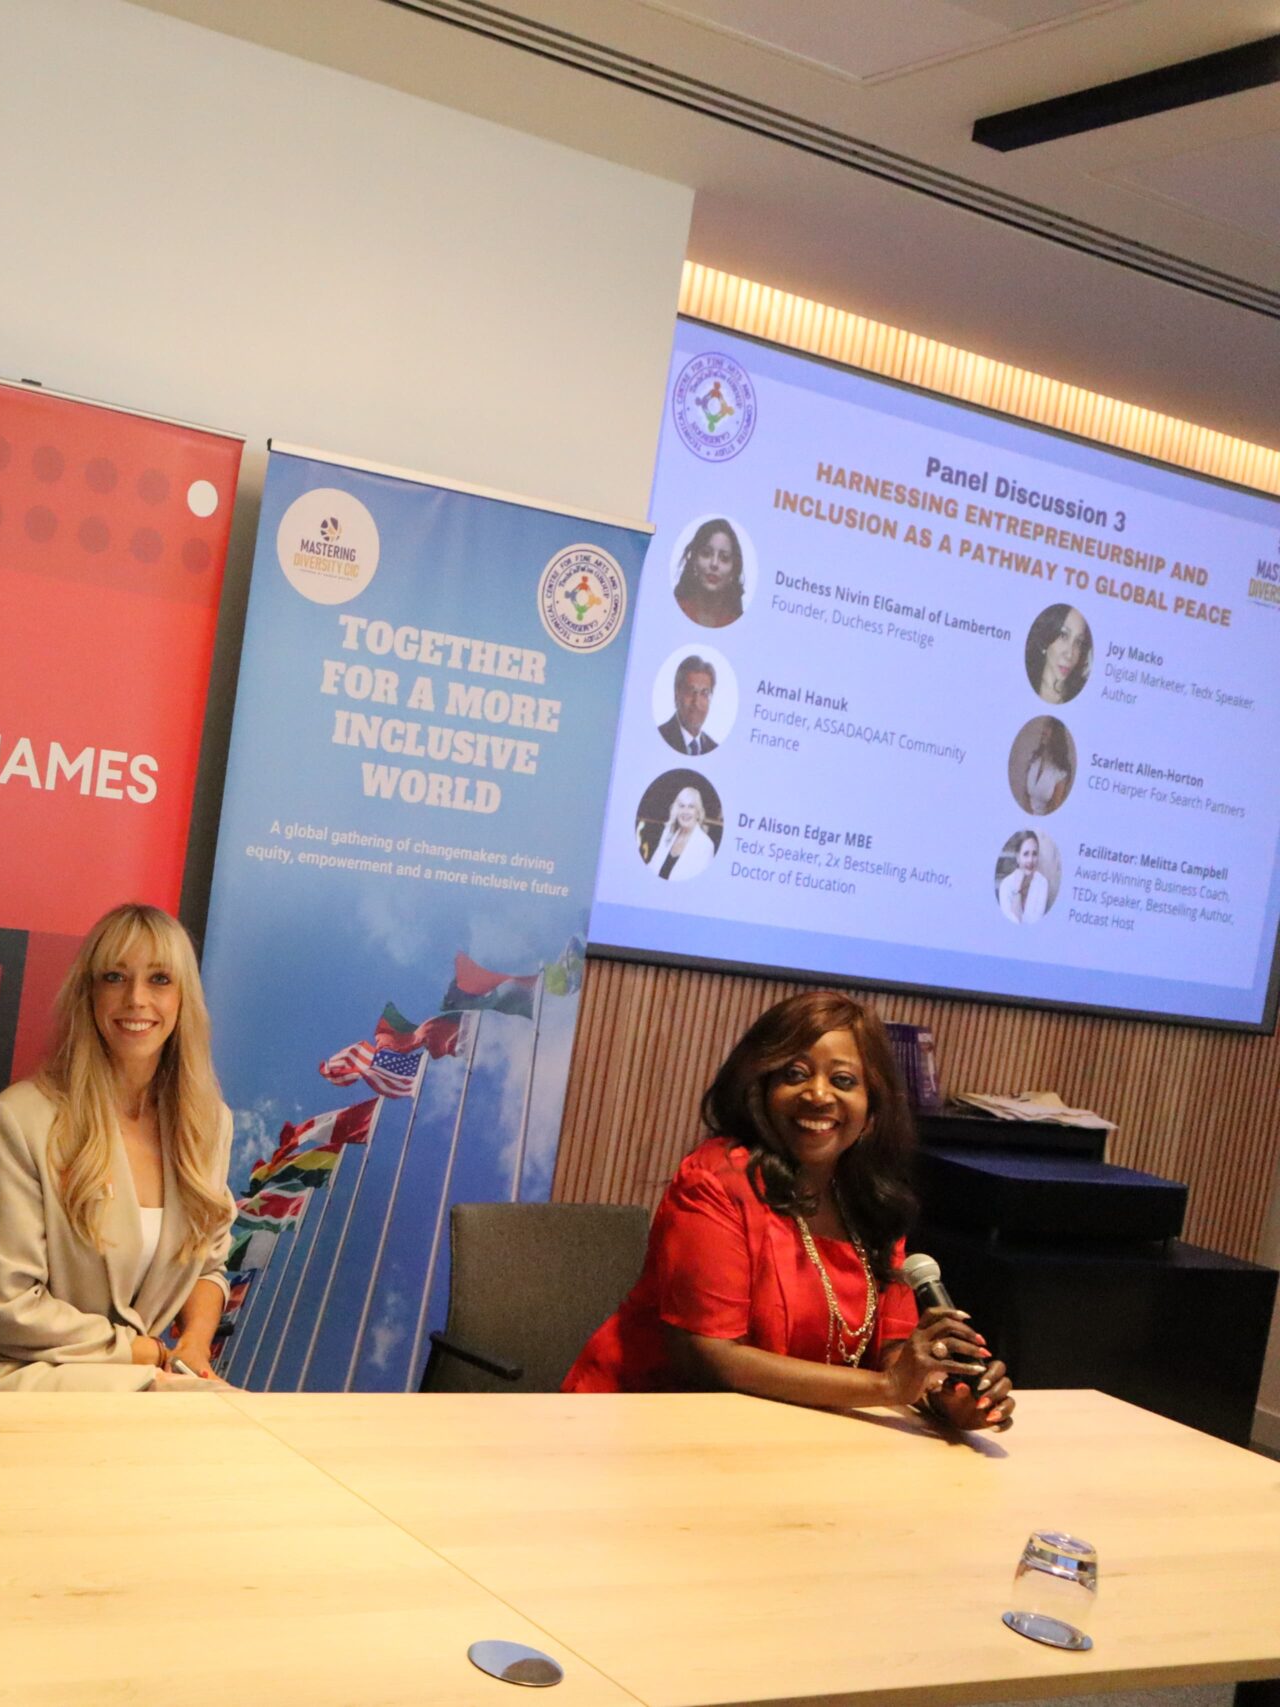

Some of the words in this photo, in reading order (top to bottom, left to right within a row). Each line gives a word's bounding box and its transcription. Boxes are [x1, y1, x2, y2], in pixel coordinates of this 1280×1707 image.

[925, 456, 989, 493] Panel
[994, 476, 1108, 527] Discussion
[1113, 511, 1127, 533] 3
[816, 461, 959, 519] HARNESSING
[965, 503, 1166, 575] ENTREPRENEURSHIP
[1170, 562, 1209, 587] AND
[293, 553, 344, 574] DIVERSITY
[344, 562, 360, 578] CIC
[300, 538, 356, 562] MASTERING
[773, 488, 899, 540] INCLUSION
[903, 524, 933, 549] AS
[938, 534, 952, 554] A
[959, 539, 1059, 581] PATHWAY
[1064, 566, 1090, 590] TO
[1095, 575, 1169, 611] GLOBAL
[1173, 596, 1232, 627] PEACE
[775, 570, 831, 598] Duchess
[835, 585, 870, 607] Nivin
[873, 595, 925, 621] ElGamal
[928, 610, 942, 625] of
[944, 612, 1012, 641] Lamberton
[1248, 576, 1280, 604] DIVER
[771, 594, 828, 625] Founder,
[831, 609, 884, 636] Duchess
[886, 622, 935, 649] Prestige
[338, 613, 547, 685] TOGETHER
[1106, 641, 1126, 661] Joy
[1127, 645, 1164, 667] Macko
[320, 659, 399, 705] FOR
[407, 676, 436, 713] A
[444, 682, 562, 734] MORE
[756, 679, 802, 703] Akmal
[805, 690, 849, 713] Hanuk
[1100, 685, 1138, 704] Author
[1104, 662, 1138, 683] Digital
[1139, 671, 1188, 696] Marketer,
[1190, 683, 1213, 700] Tedx
[1215, 689, 1256, 712] Speaker,
[331, 709, 540, 775] INCLUSIVE
[749, 728, 800, 752] Finance
[753, 703, 811, 732] Founder,
[813, 717, 896, 746] ASSADAQAAT
[898, 733, 967, 764] Community
[361, 761, 502, 815] WORLD
[1090, 753, 1134, 774] Scarlett
[1136, 762, 1204, 788] Allen-Horton
[1087, 775, 1110, 791] CEO
[1112, 781, 1148, 800] Harper
[1150, 787, 1168, 801] Fox
[1169, 791, 1203, 810] Search
[1205, 798, 1246, 818] Partners
[270, 820, 281, 835] A
[284, 821, 328, 841] global
[331, 827, 394, 852] gathering
[396, 838, 410, 852] of
[413, 839, 508, 866] changemakers
[510, 852, 555, 874] driving
[737, 813, 755, 829] Dr
[757, 816, 801, 838] Alison
[804, 824, 841, 846] Edgar
[844, 832, 873, 850] MBE
[245, 843, 295, 866] equity,
[298, 850, 393, 876] empowerment
[395, 861, 421, 879] and
[424, 868, 433, 880] a
[435, 869, 469, 885] more
[470, 871, 529, 892] inclusive
[531, 877, 570, 898] future
[730, 861, 776, 882] Doctor
[778, 870, 793, 884] of
[795, 871, 856, 895] Education
[734, 836, 765, 857] Tedx
[768, 842, 822, 868] Speaker,
[825, 852, 840, 869] 2x
[843, 855, 907, 884] Bestselling
[909, 866, 953, 888] Author,
[1074, 866, 1153, 893] Award-Winning
[1154, 877, 1197, 898] Business
[1078, 843, 1138, 866] Facilitator:
[1140, 853, 1178, 872] Melitta
[1180, 861, 1229, 881] Campbell
[1068, 908, 1109, 927] Podcast
[1111, 915, 1135, 931] Host
[1072, 886, 1098, 903] TEDx
[1100, 891, 1143, 912] Speaker,
[1145, 898, 1199, 922] Bestselling
[1199, 907, 1234, 926] Author,
